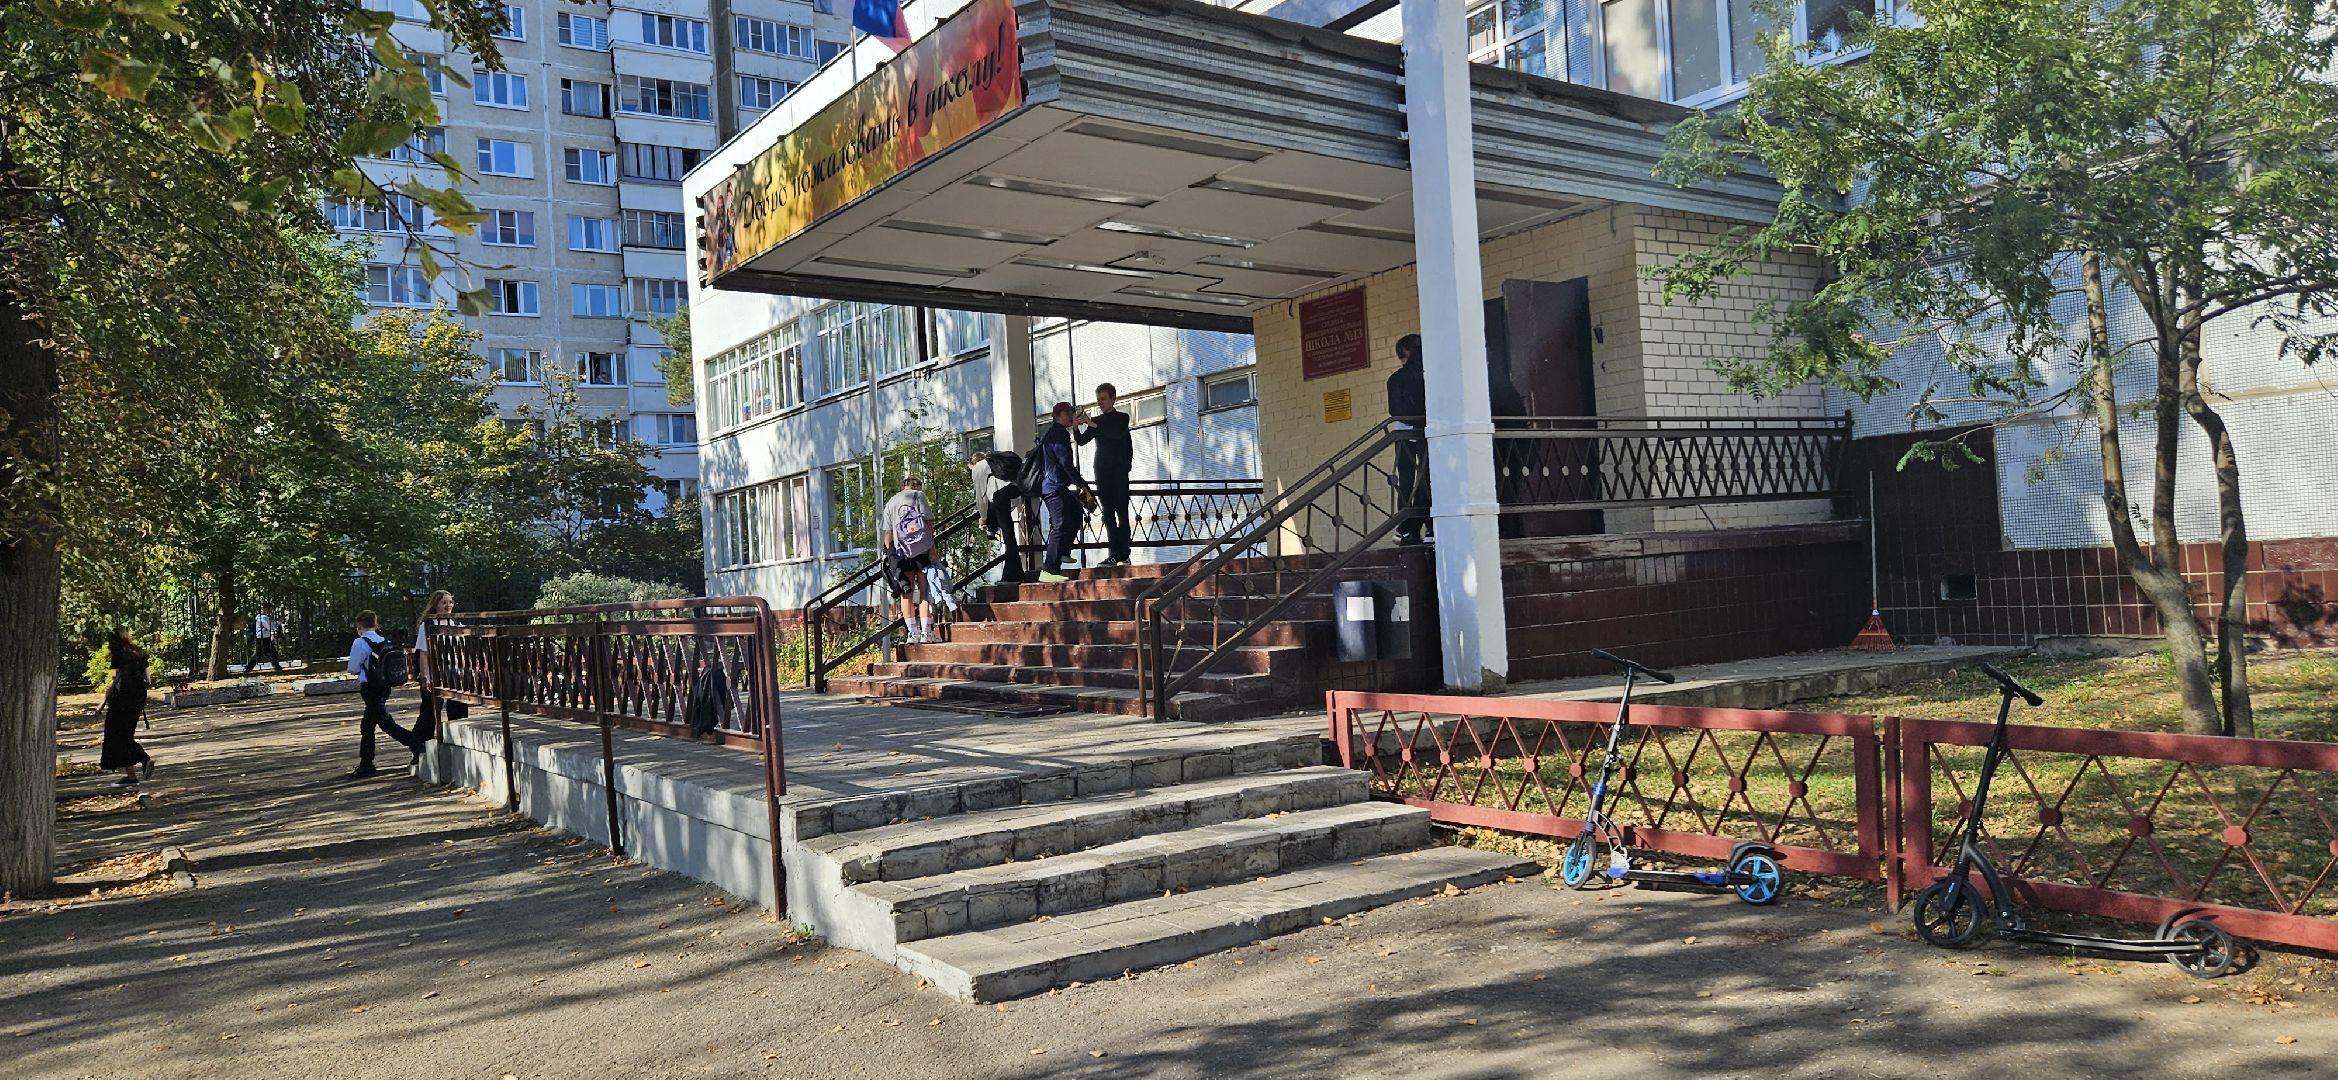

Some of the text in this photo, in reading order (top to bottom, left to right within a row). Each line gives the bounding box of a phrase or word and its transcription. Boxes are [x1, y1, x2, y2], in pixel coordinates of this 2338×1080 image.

[739, 21, 1005, 228] Добро пожаловать в школу!
[1305, 334, 1340, 351] ШКОЛА
[1345, 328, 1362, 342] №13
